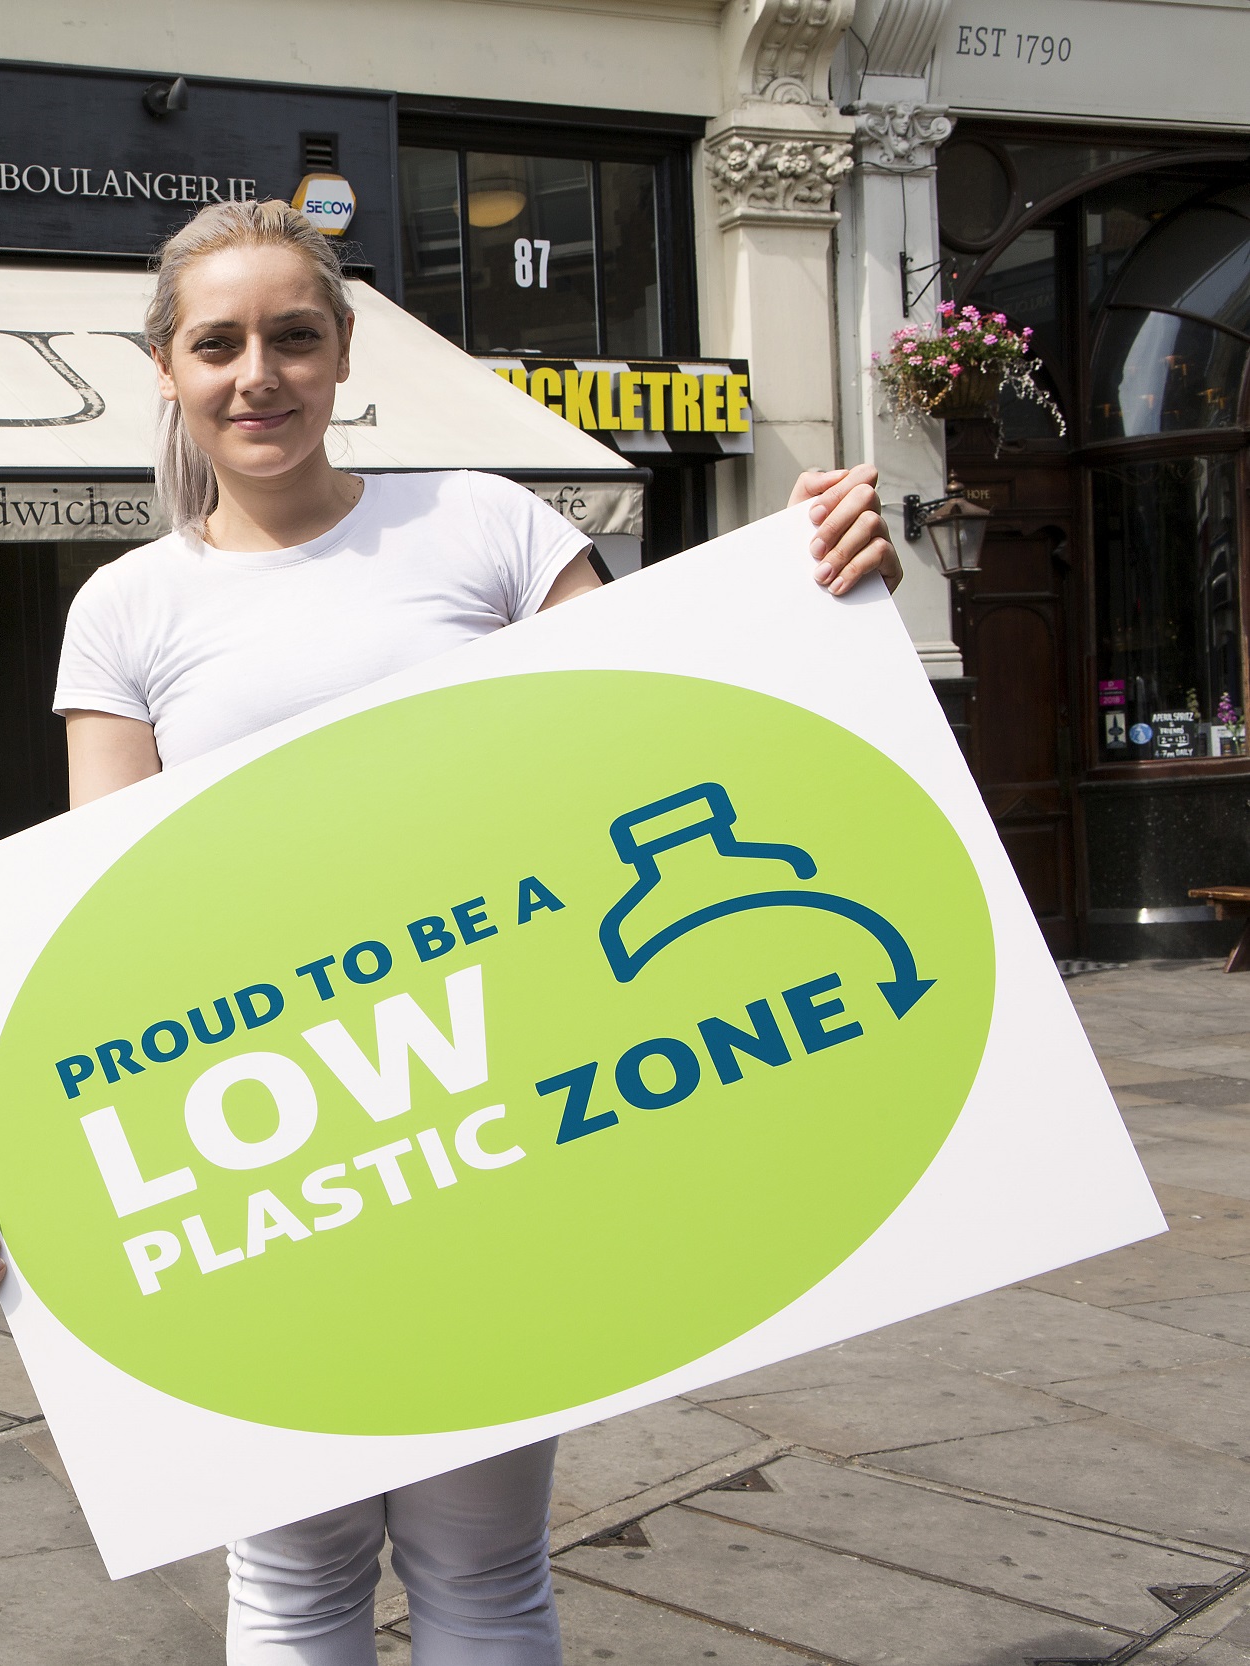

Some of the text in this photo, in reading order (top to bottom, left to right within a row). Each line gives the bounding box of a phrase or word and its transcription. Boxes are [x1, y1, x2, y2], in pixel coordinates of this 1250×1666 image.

[956, 25, 1071, 66] EST 1790
[306, 200, 353, 216] SECOM
[514, 238, 551, 288] 87
[526, 486, 588, 521] fé
[55, 876, 565, 1099] PROUD TO BE A
[80, 965, 489, 1219] LOW
[123, 972, 864, 1296] PLASTIC ZONE
